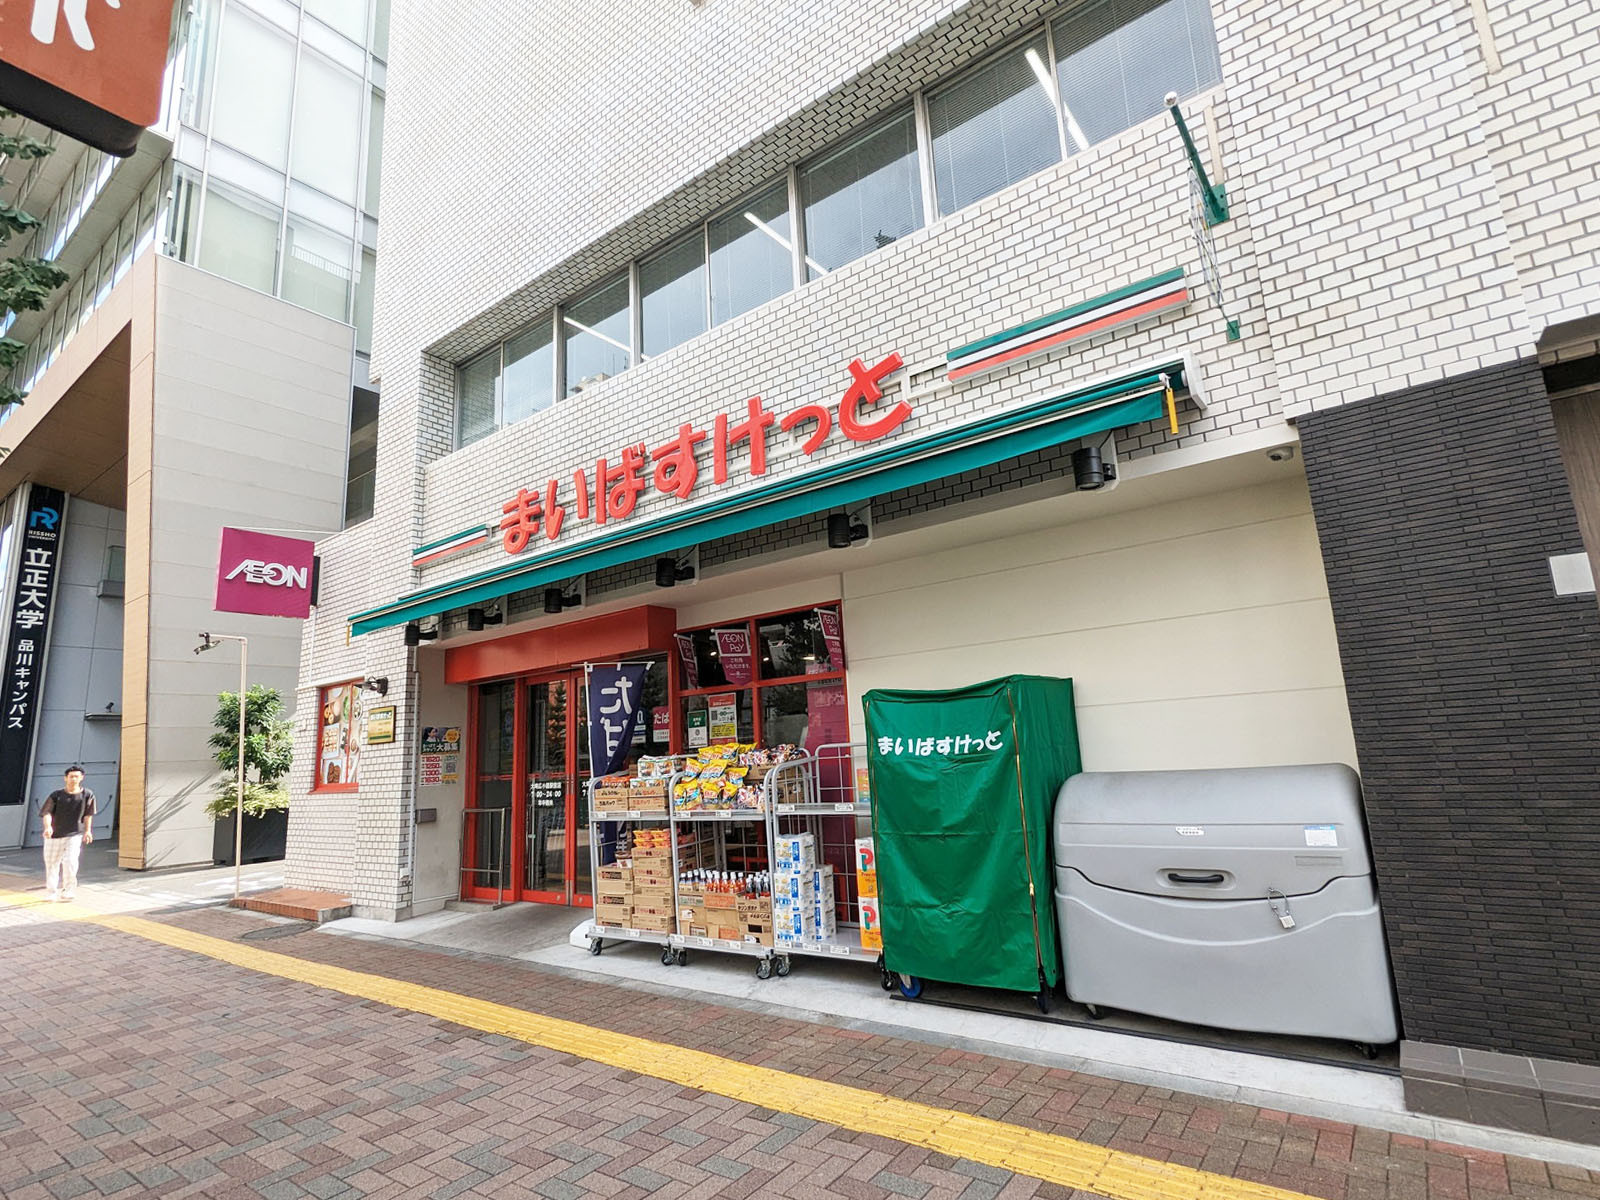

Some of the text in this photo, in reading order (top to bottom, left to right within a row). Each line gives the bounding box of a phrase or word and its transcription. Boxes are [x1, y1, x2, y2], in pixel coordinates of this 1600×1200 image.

[500, 351, 913, 555] まいばすけっと
[28, 530, 56, 538] RISSHO
[8, 547, 52, 729] 立正大学 品川キャンパス
[877, 730, 1004, 756] まいばすけっと
